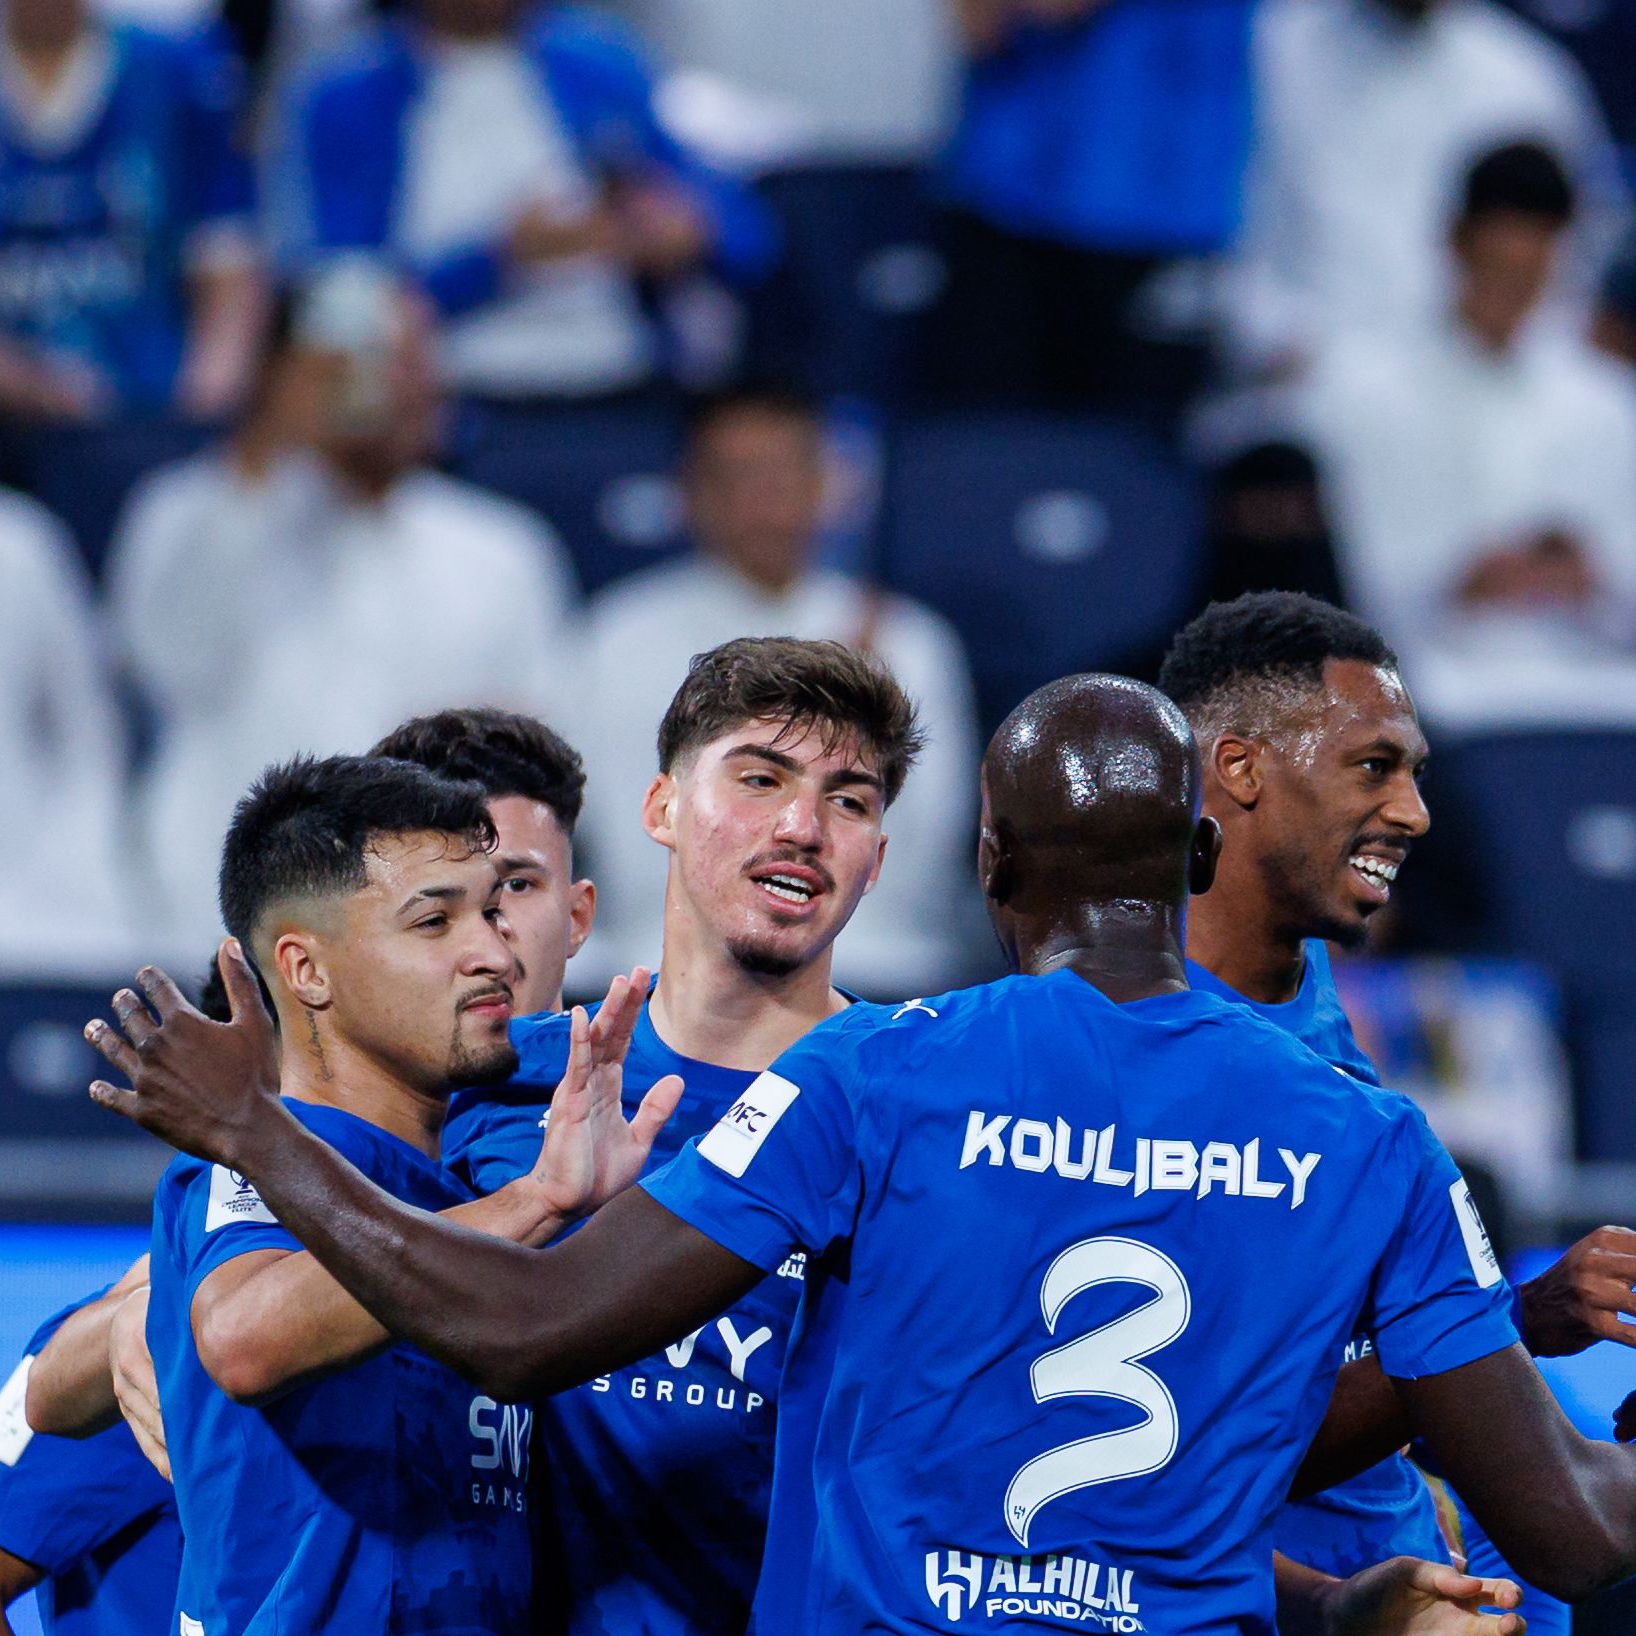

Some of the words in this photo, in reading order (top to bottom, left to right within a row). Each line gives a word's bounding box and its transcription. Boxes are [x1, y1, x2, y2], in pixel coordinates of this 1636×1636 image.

[959, 1110, 1322, 1210] KOULIBALY
[630, 1377, 764, 1413] GROUP
[1004, 1235, 1192, 1549] 3
[987, 1554, 1139, 1614] ALHILAL
